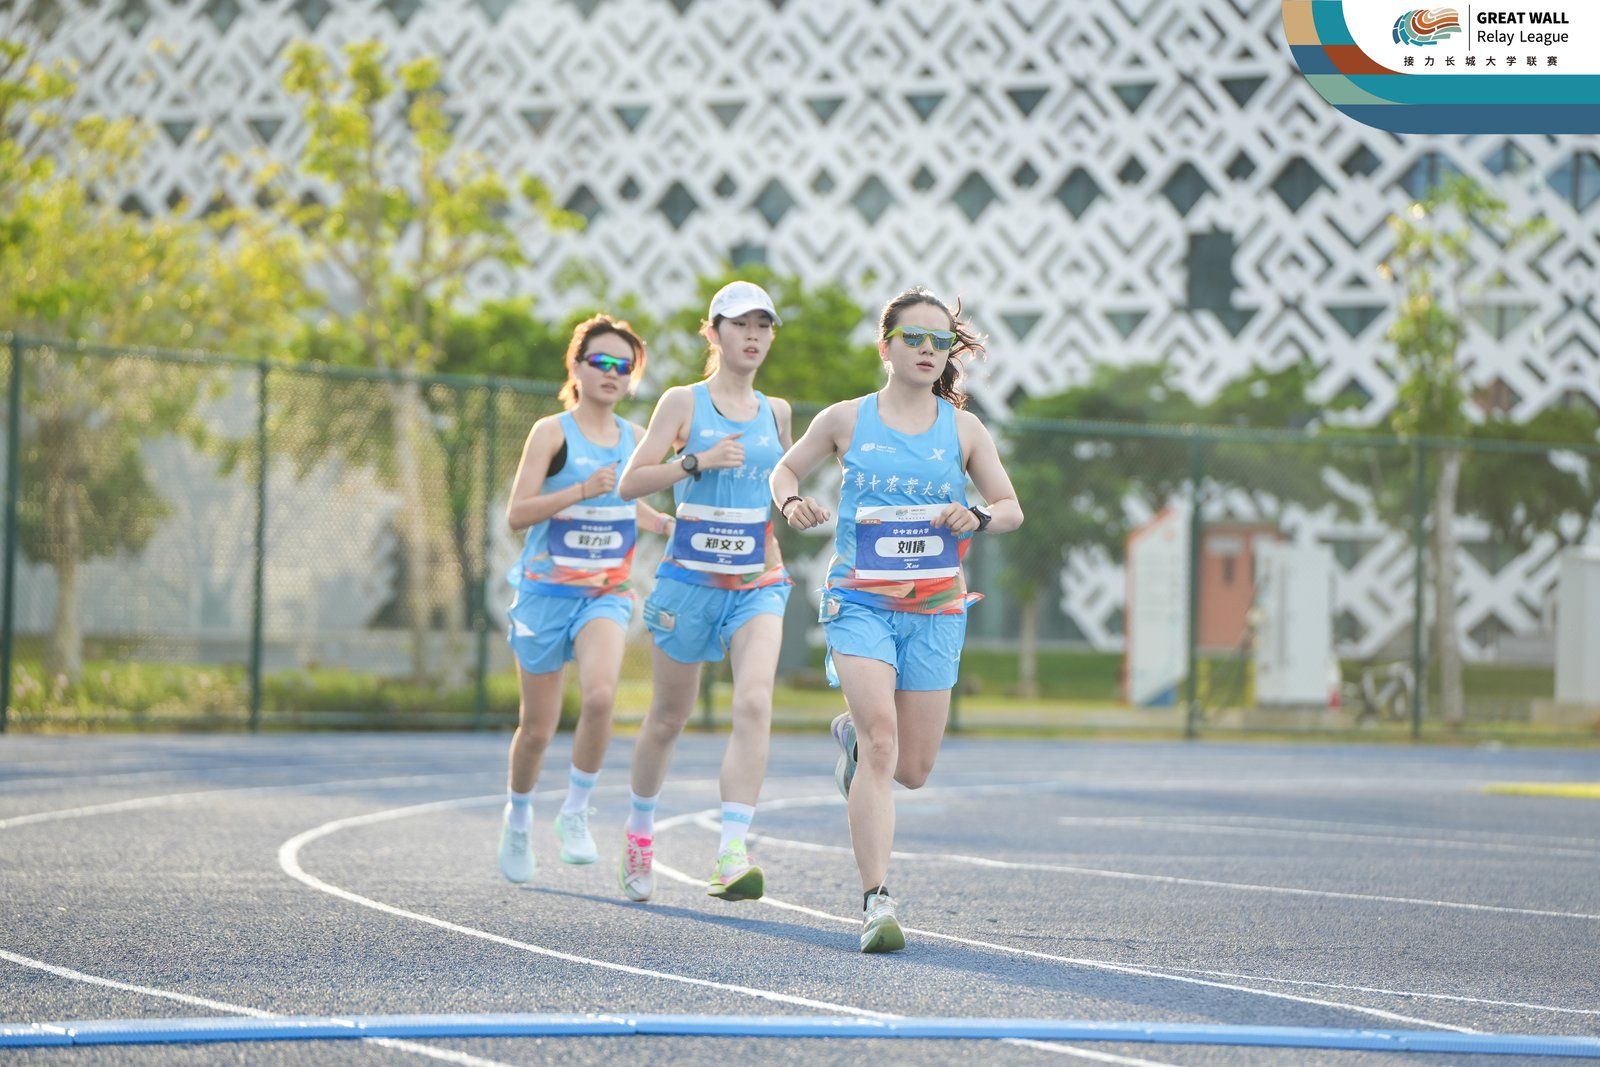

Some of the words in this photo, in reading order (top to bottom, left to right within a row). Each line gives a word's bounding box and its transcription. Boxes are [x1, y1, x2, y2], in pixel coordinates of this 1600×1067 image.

[705, 537, 746, 551] 郑文文
[897, 540, 926, 554] 刘倩
